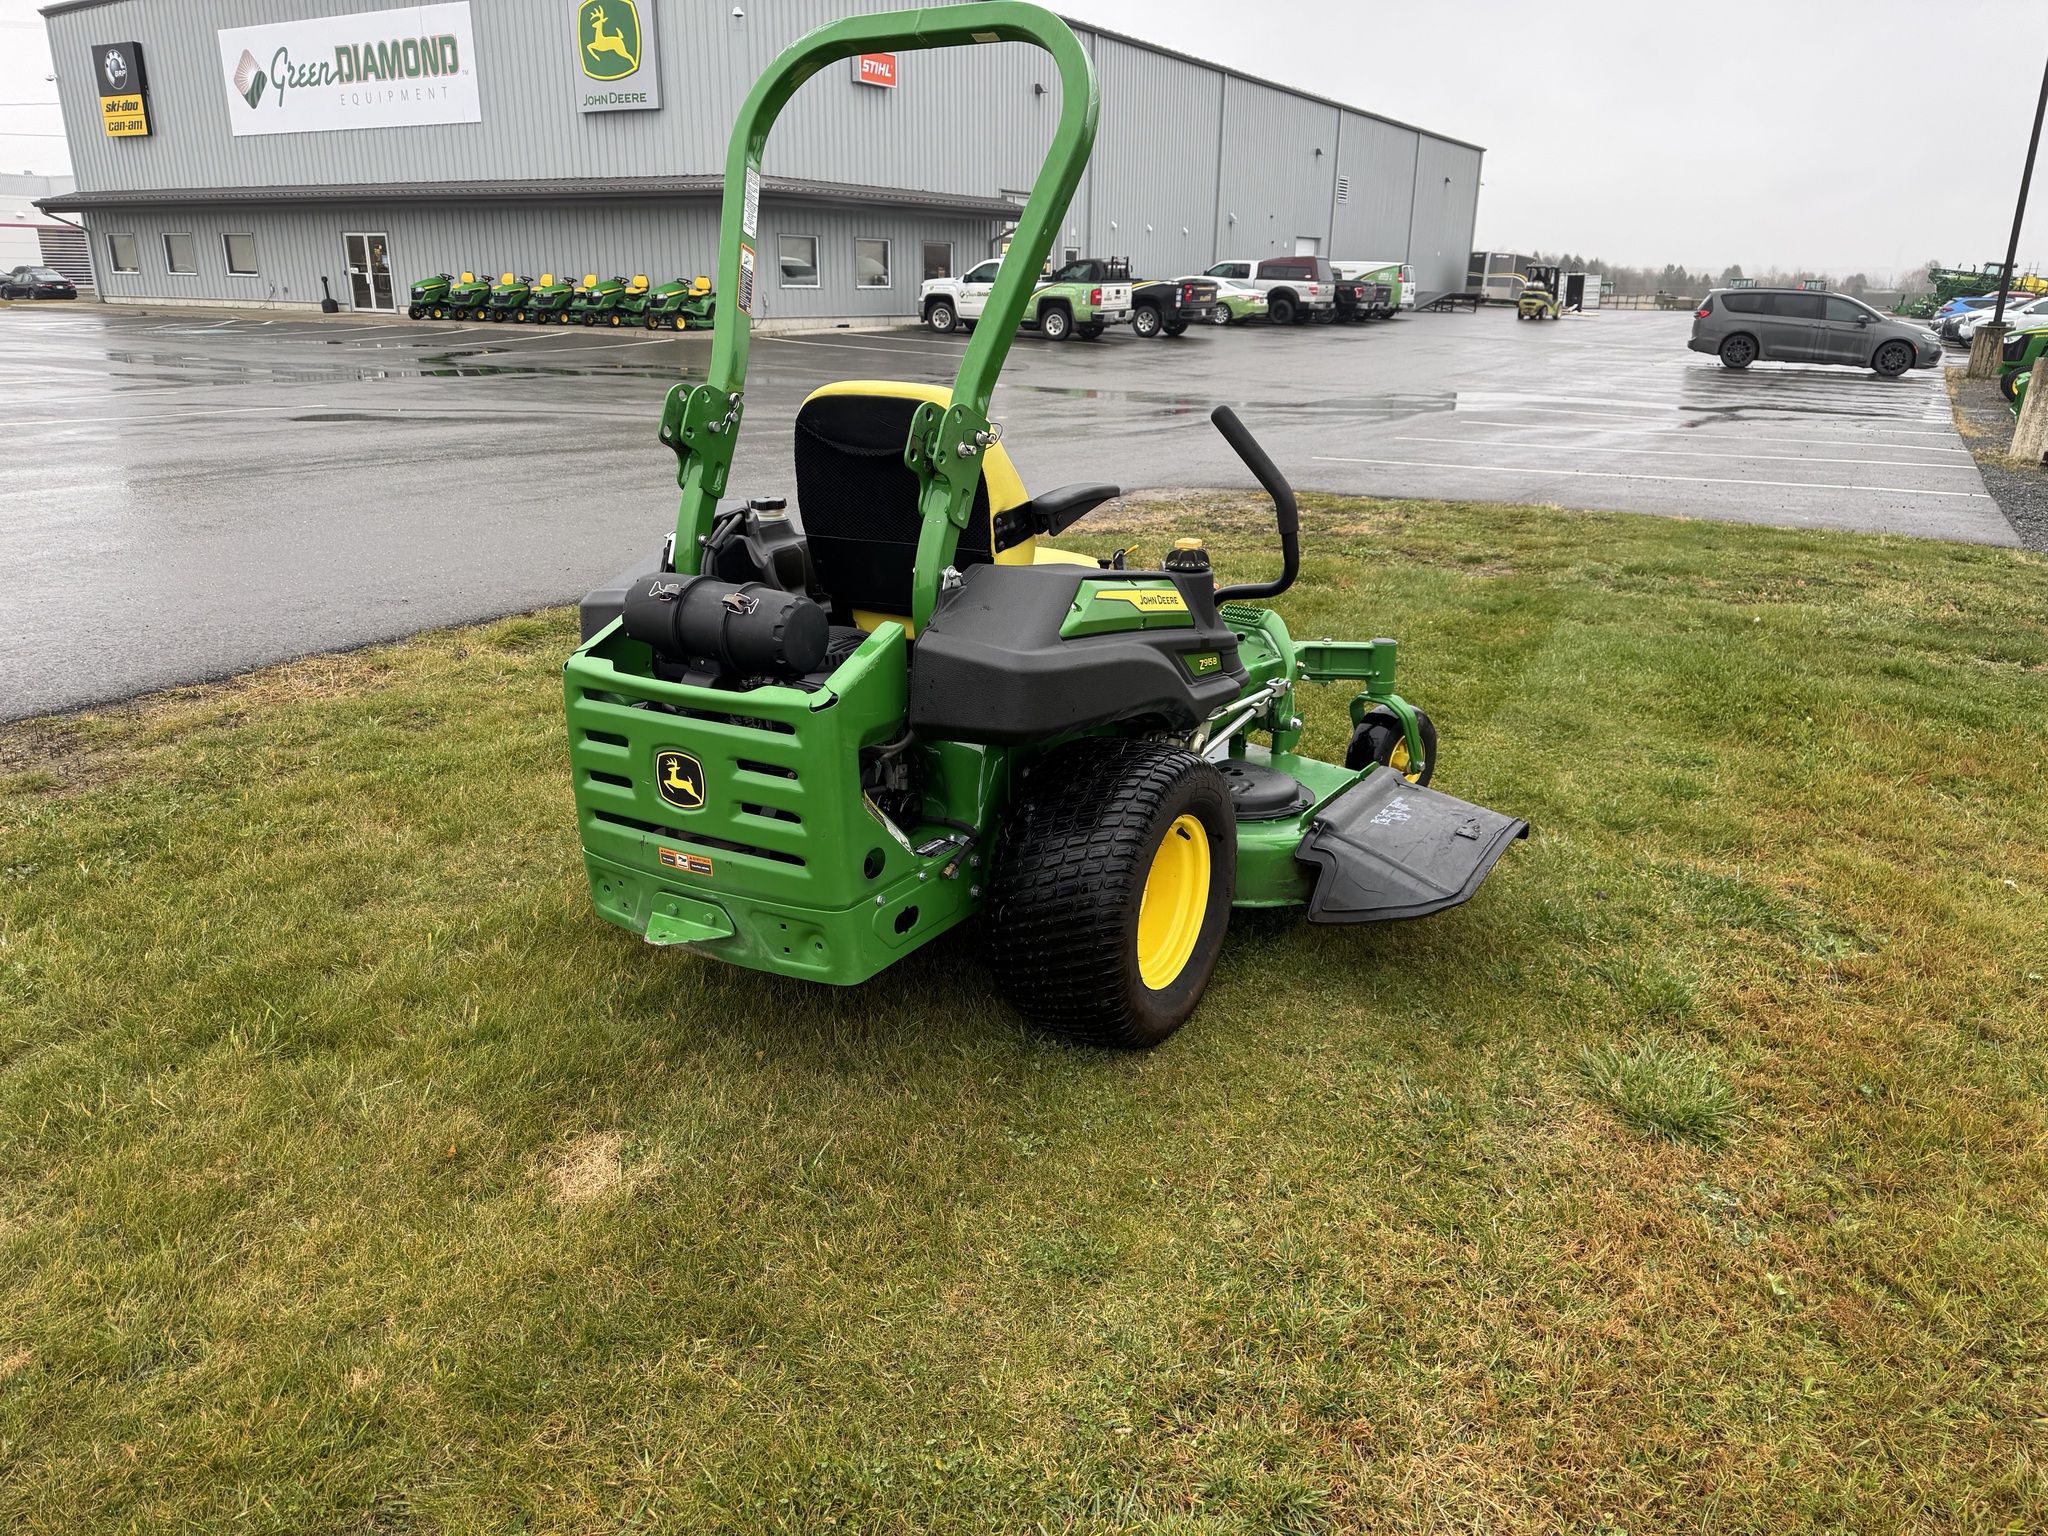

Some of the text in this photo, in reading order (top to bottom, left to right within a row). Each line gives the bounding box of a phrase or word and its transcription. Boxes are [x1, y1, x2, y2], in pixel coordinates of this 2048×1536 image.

[114, 69, 126, 78] BRP
[271, 46, 339, 107] Green
[334, 33, 460, 85] DIAMOND
[862, 59, 892, 77] STIHL
[340, 86, 448, 106] EQUIPMENT
[583, 92, 647, 106] JOHN DEERE
[105, 100, 138, 112] ski-doo
[108, 120, 142, 131] can-am
[1140, 594, 1179, 605] JOHN DEERE
[1199, 657, 1217, 670] Z915B
